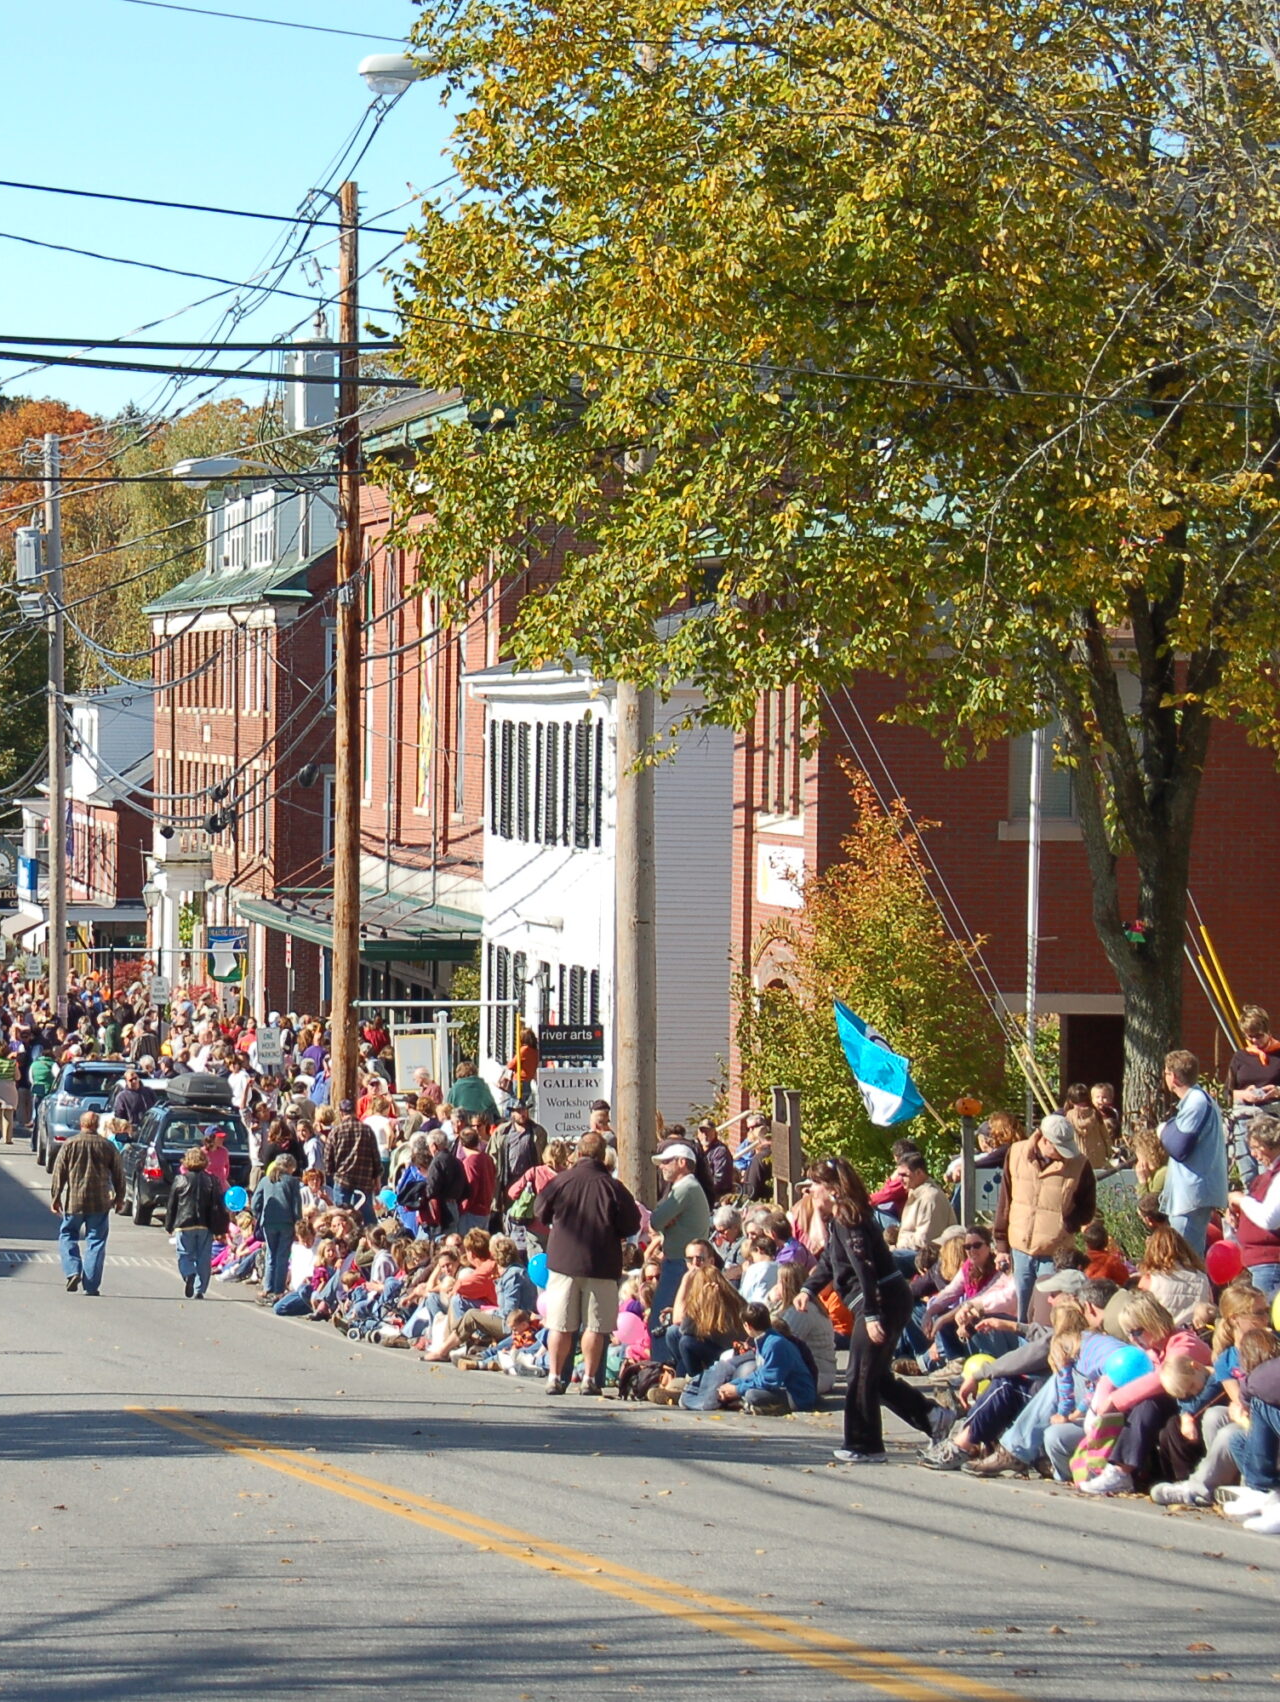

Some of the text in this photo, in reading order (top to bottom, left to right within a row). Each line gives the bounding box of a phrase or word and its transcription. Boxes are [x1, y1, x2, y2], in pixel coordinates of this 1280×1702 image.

[263, 1032, 273, 1040] ONE
[541, 1029, 593, 1040] river arts
[543, 1079, 601, 1089] GALLERY
[546, 1097, 594, 1112] Workshop
[564, 1110, 581, 1120] and
[555, 1123, 591, 1132] Classes
